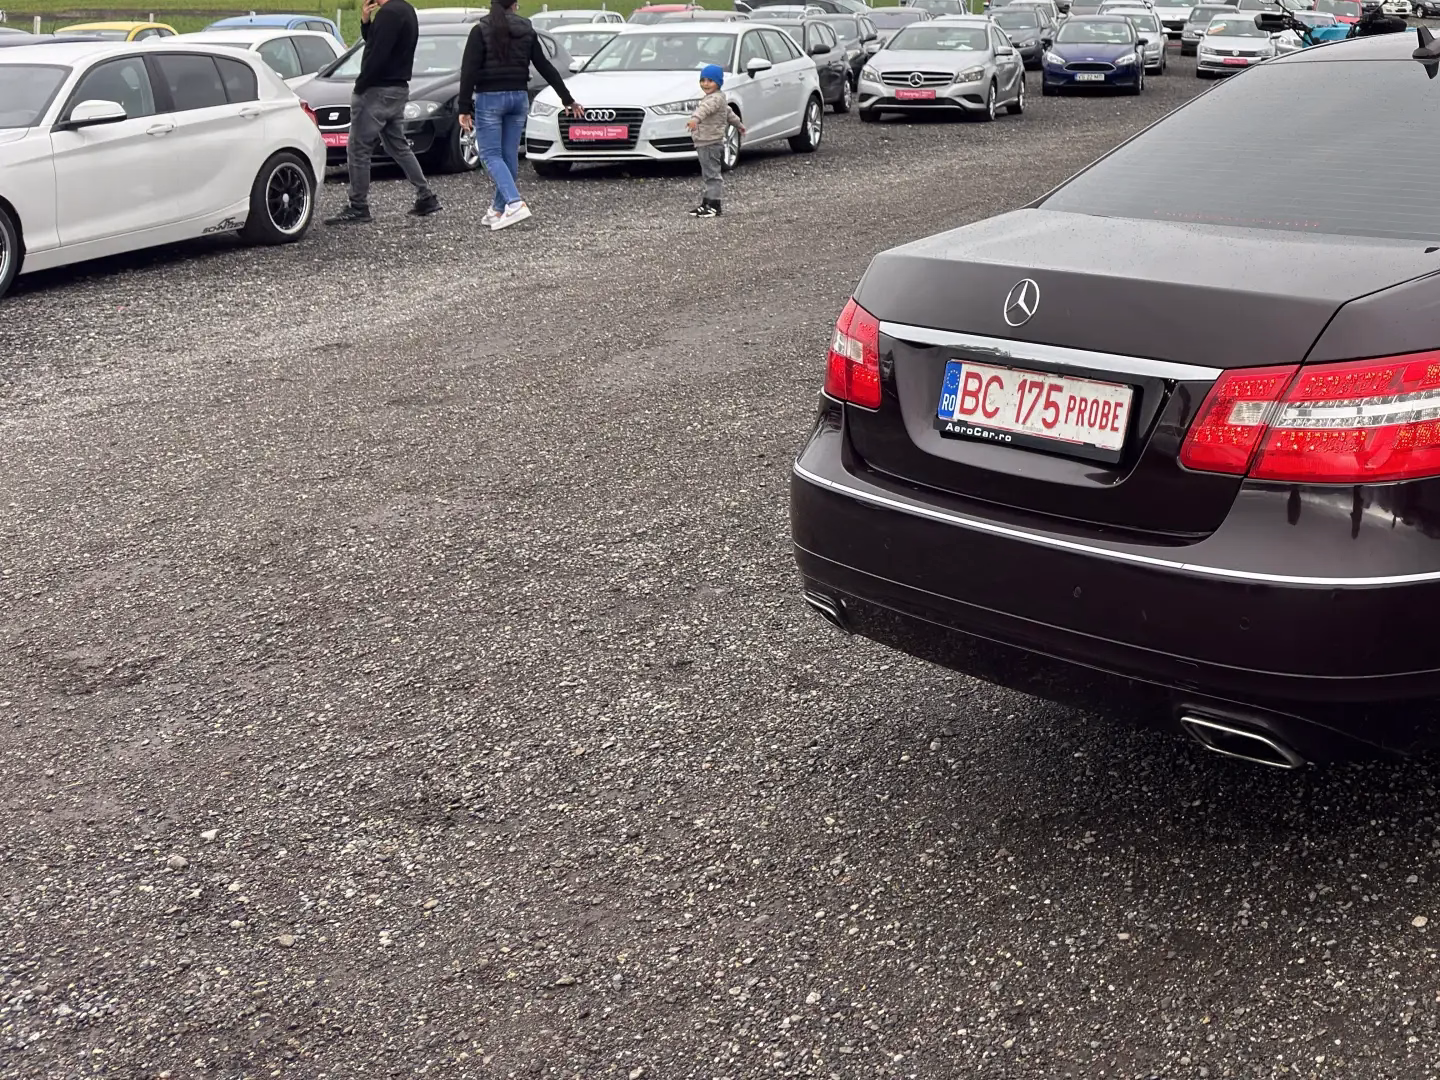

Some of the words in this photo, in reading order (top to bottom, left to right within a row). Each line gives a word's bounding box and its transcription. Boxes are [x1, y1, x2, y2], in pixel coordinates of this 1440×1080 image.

[942, 393, 956, 411] RO
[959, 371, 1004, 418] BC
[1015, 378, 1063, 429] 175
[1064, 395, 1123, 432] PROBE
[945, 422, 1012, 442] AeroCar.ro
